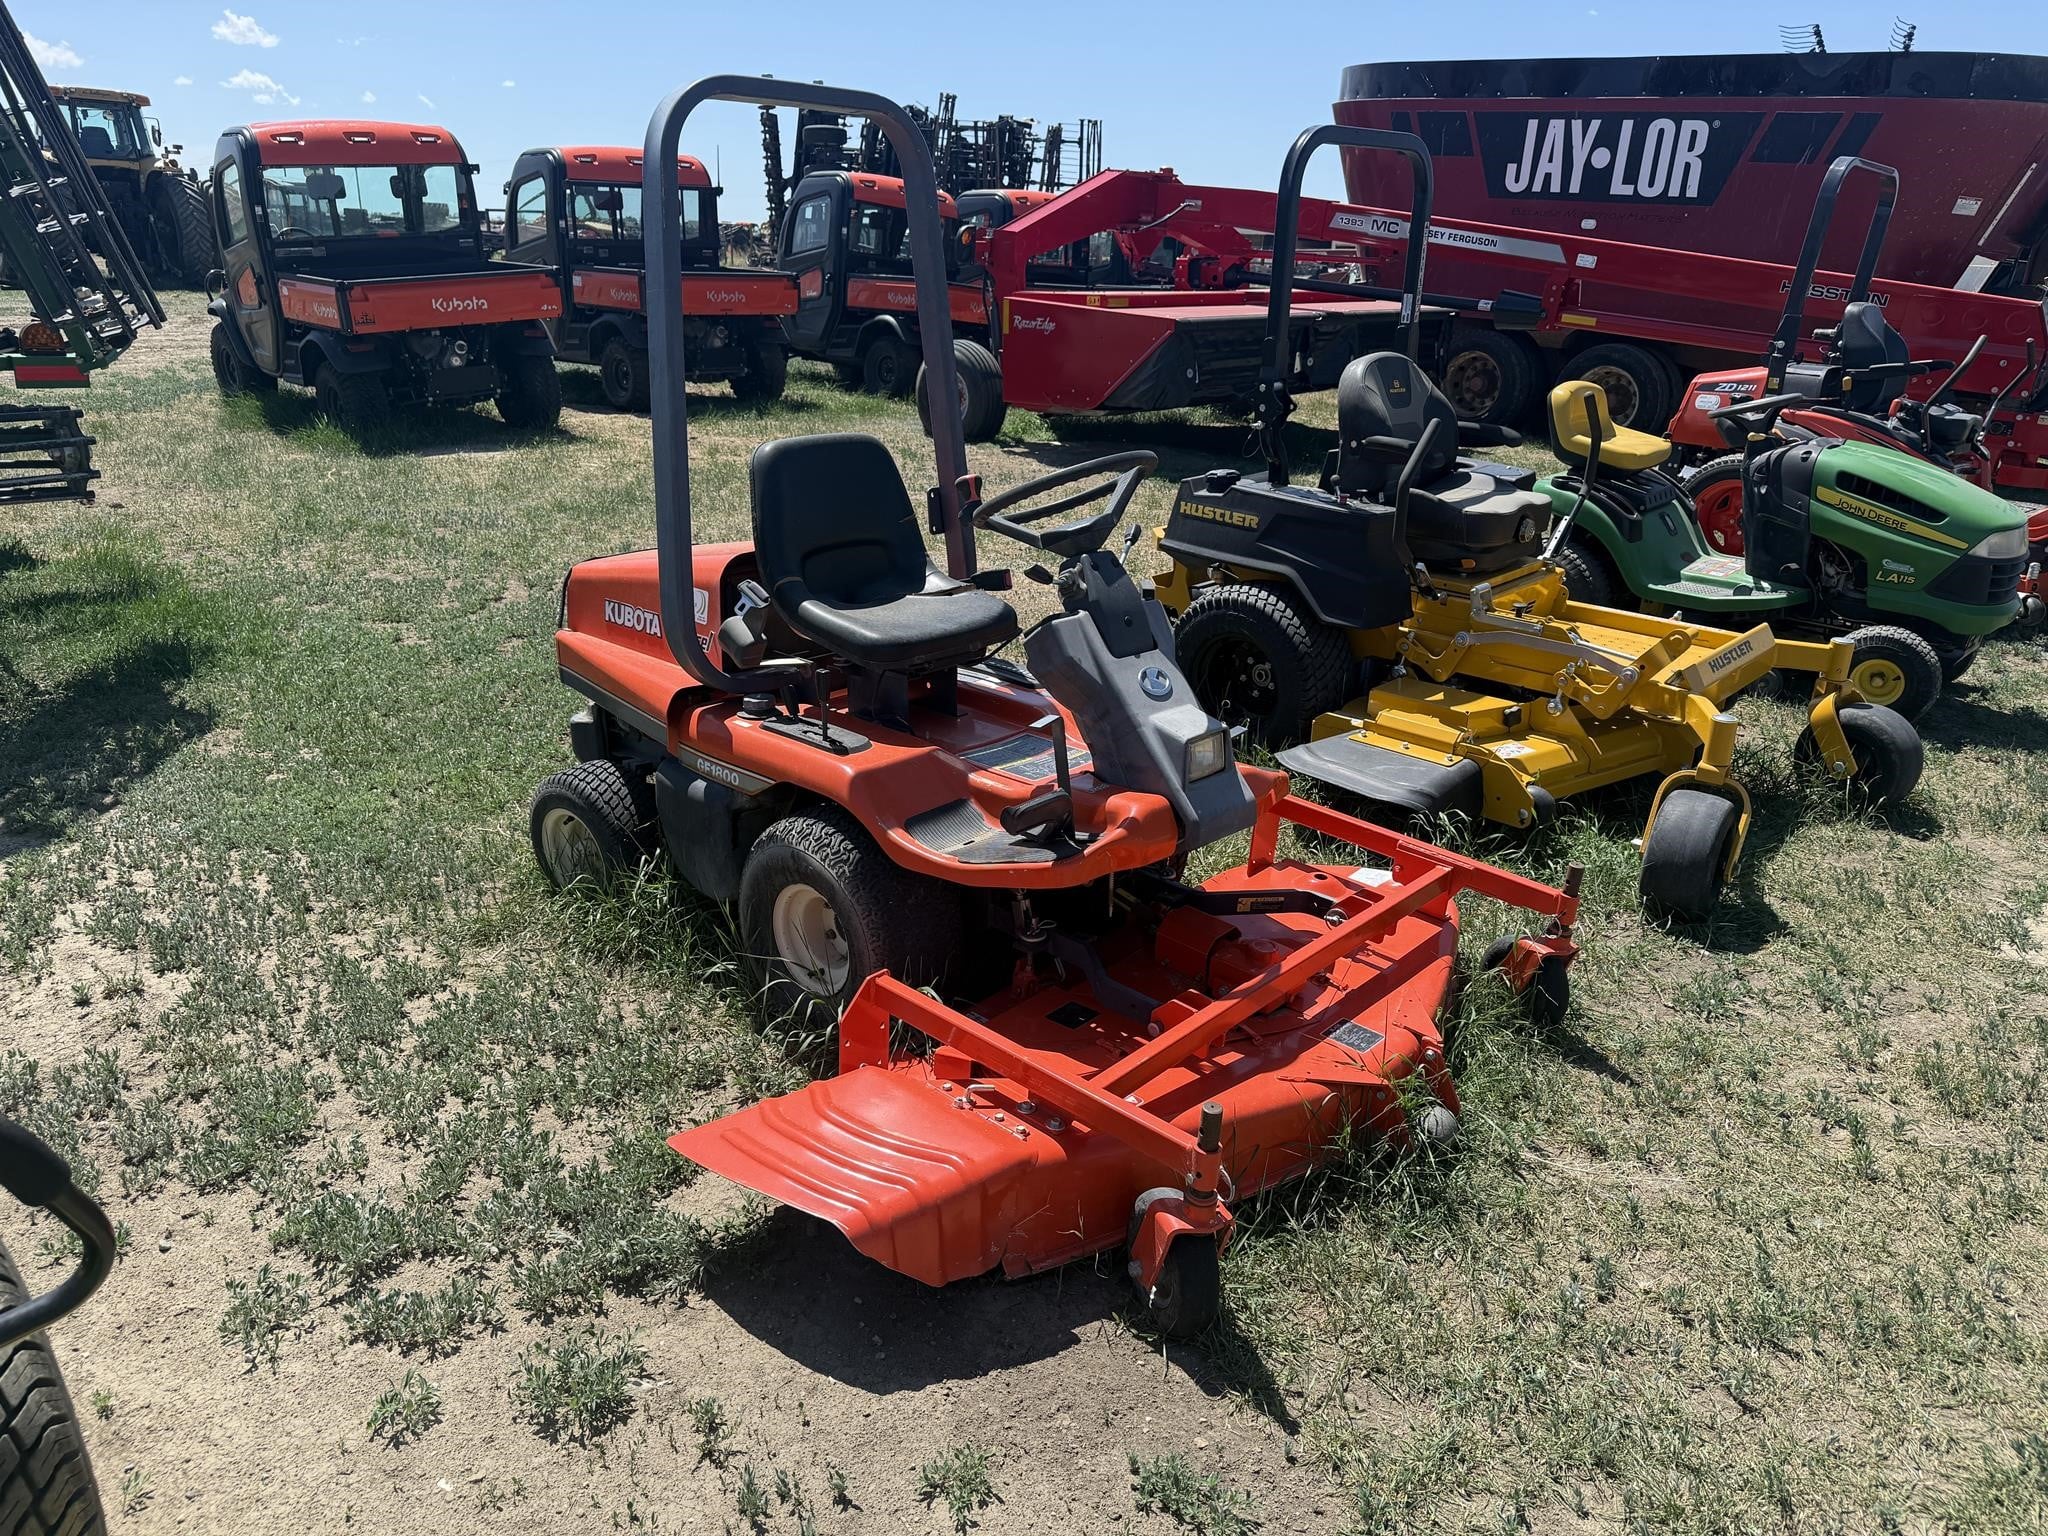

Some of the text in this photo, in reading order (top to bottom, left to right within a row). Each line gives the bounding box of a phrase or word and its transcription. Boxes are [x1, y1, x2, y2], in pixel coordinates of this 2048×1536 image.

[1338, 216, 1498, 248] 1393 MC SEY FERGUSON
[431, 296, 488, 312] Kubota
[610, 288, 638, 302] Kubota
[706, 290, 746, 303] Kubota
[1779, 280, 1890, 307] HSSTN
[312, 302, 338, 319] Kubota
[1013, 315, 1056, 334] RazorEdge
[1180, 501, 1259, 528] HUSTLER
[1834, 498, 1908, 531] JOHN DEERE
[604, 599, 662, 638] KUBOTA
[1708, 640, 1754, 673] HUSTLER
[697, 758, 739, 785] GF1800
